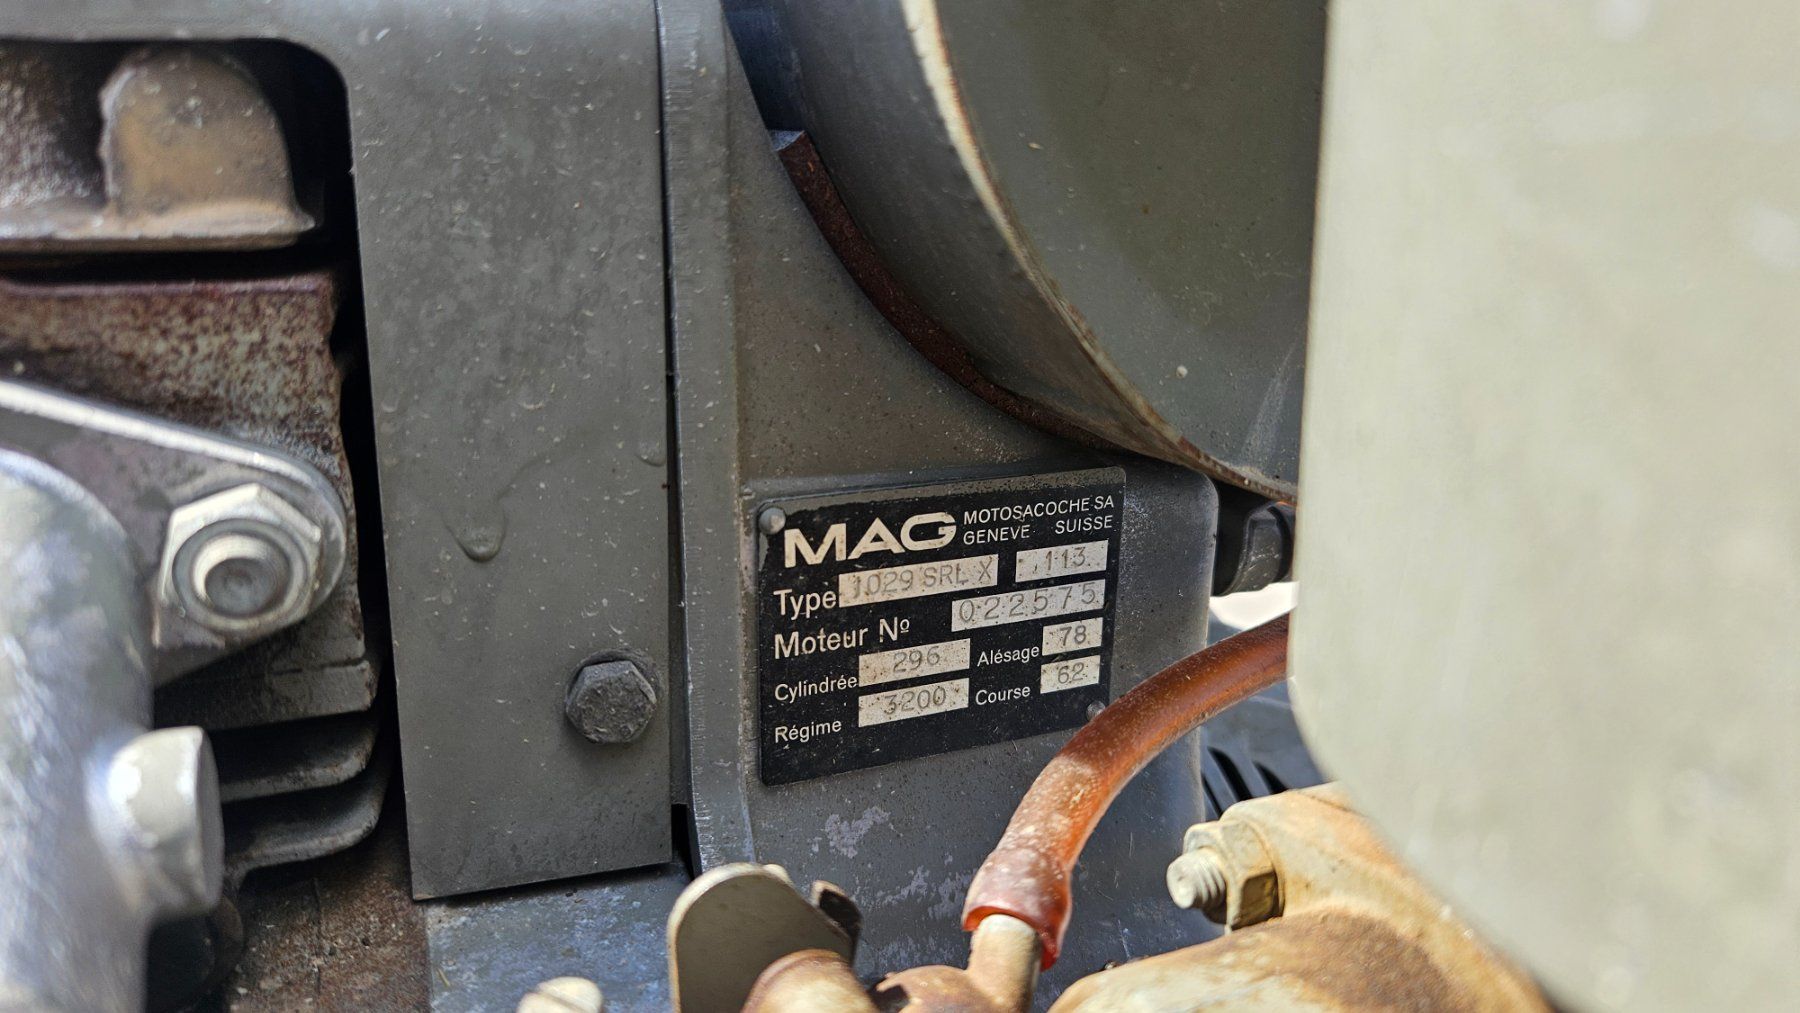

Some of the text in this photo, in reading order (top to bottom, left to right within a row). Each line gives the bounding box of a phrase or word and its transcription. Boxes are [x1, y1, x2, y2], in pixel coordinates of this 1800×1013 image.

[963, 495, 1115, 526] MOTOSACOCHE SA
[963, 515, 1114, 546] GENEVE SUISSE
[784, 512, 957, 569] MAG
[773, 588, 837, 621] Type
[852, 569, 914, 600] 1029
[923, 562, 969, 588] SRL
[774, 627, 869, 660] Moteur
[959, 581, 1096, 624] 022575
[976, 624, 1088, 668] Alésage 78
[774, 646, 941, 704] Cylindrée 296
[975, 662, 1085, 706] Course 62
[774, 686, 948, 744] Régime 3200
